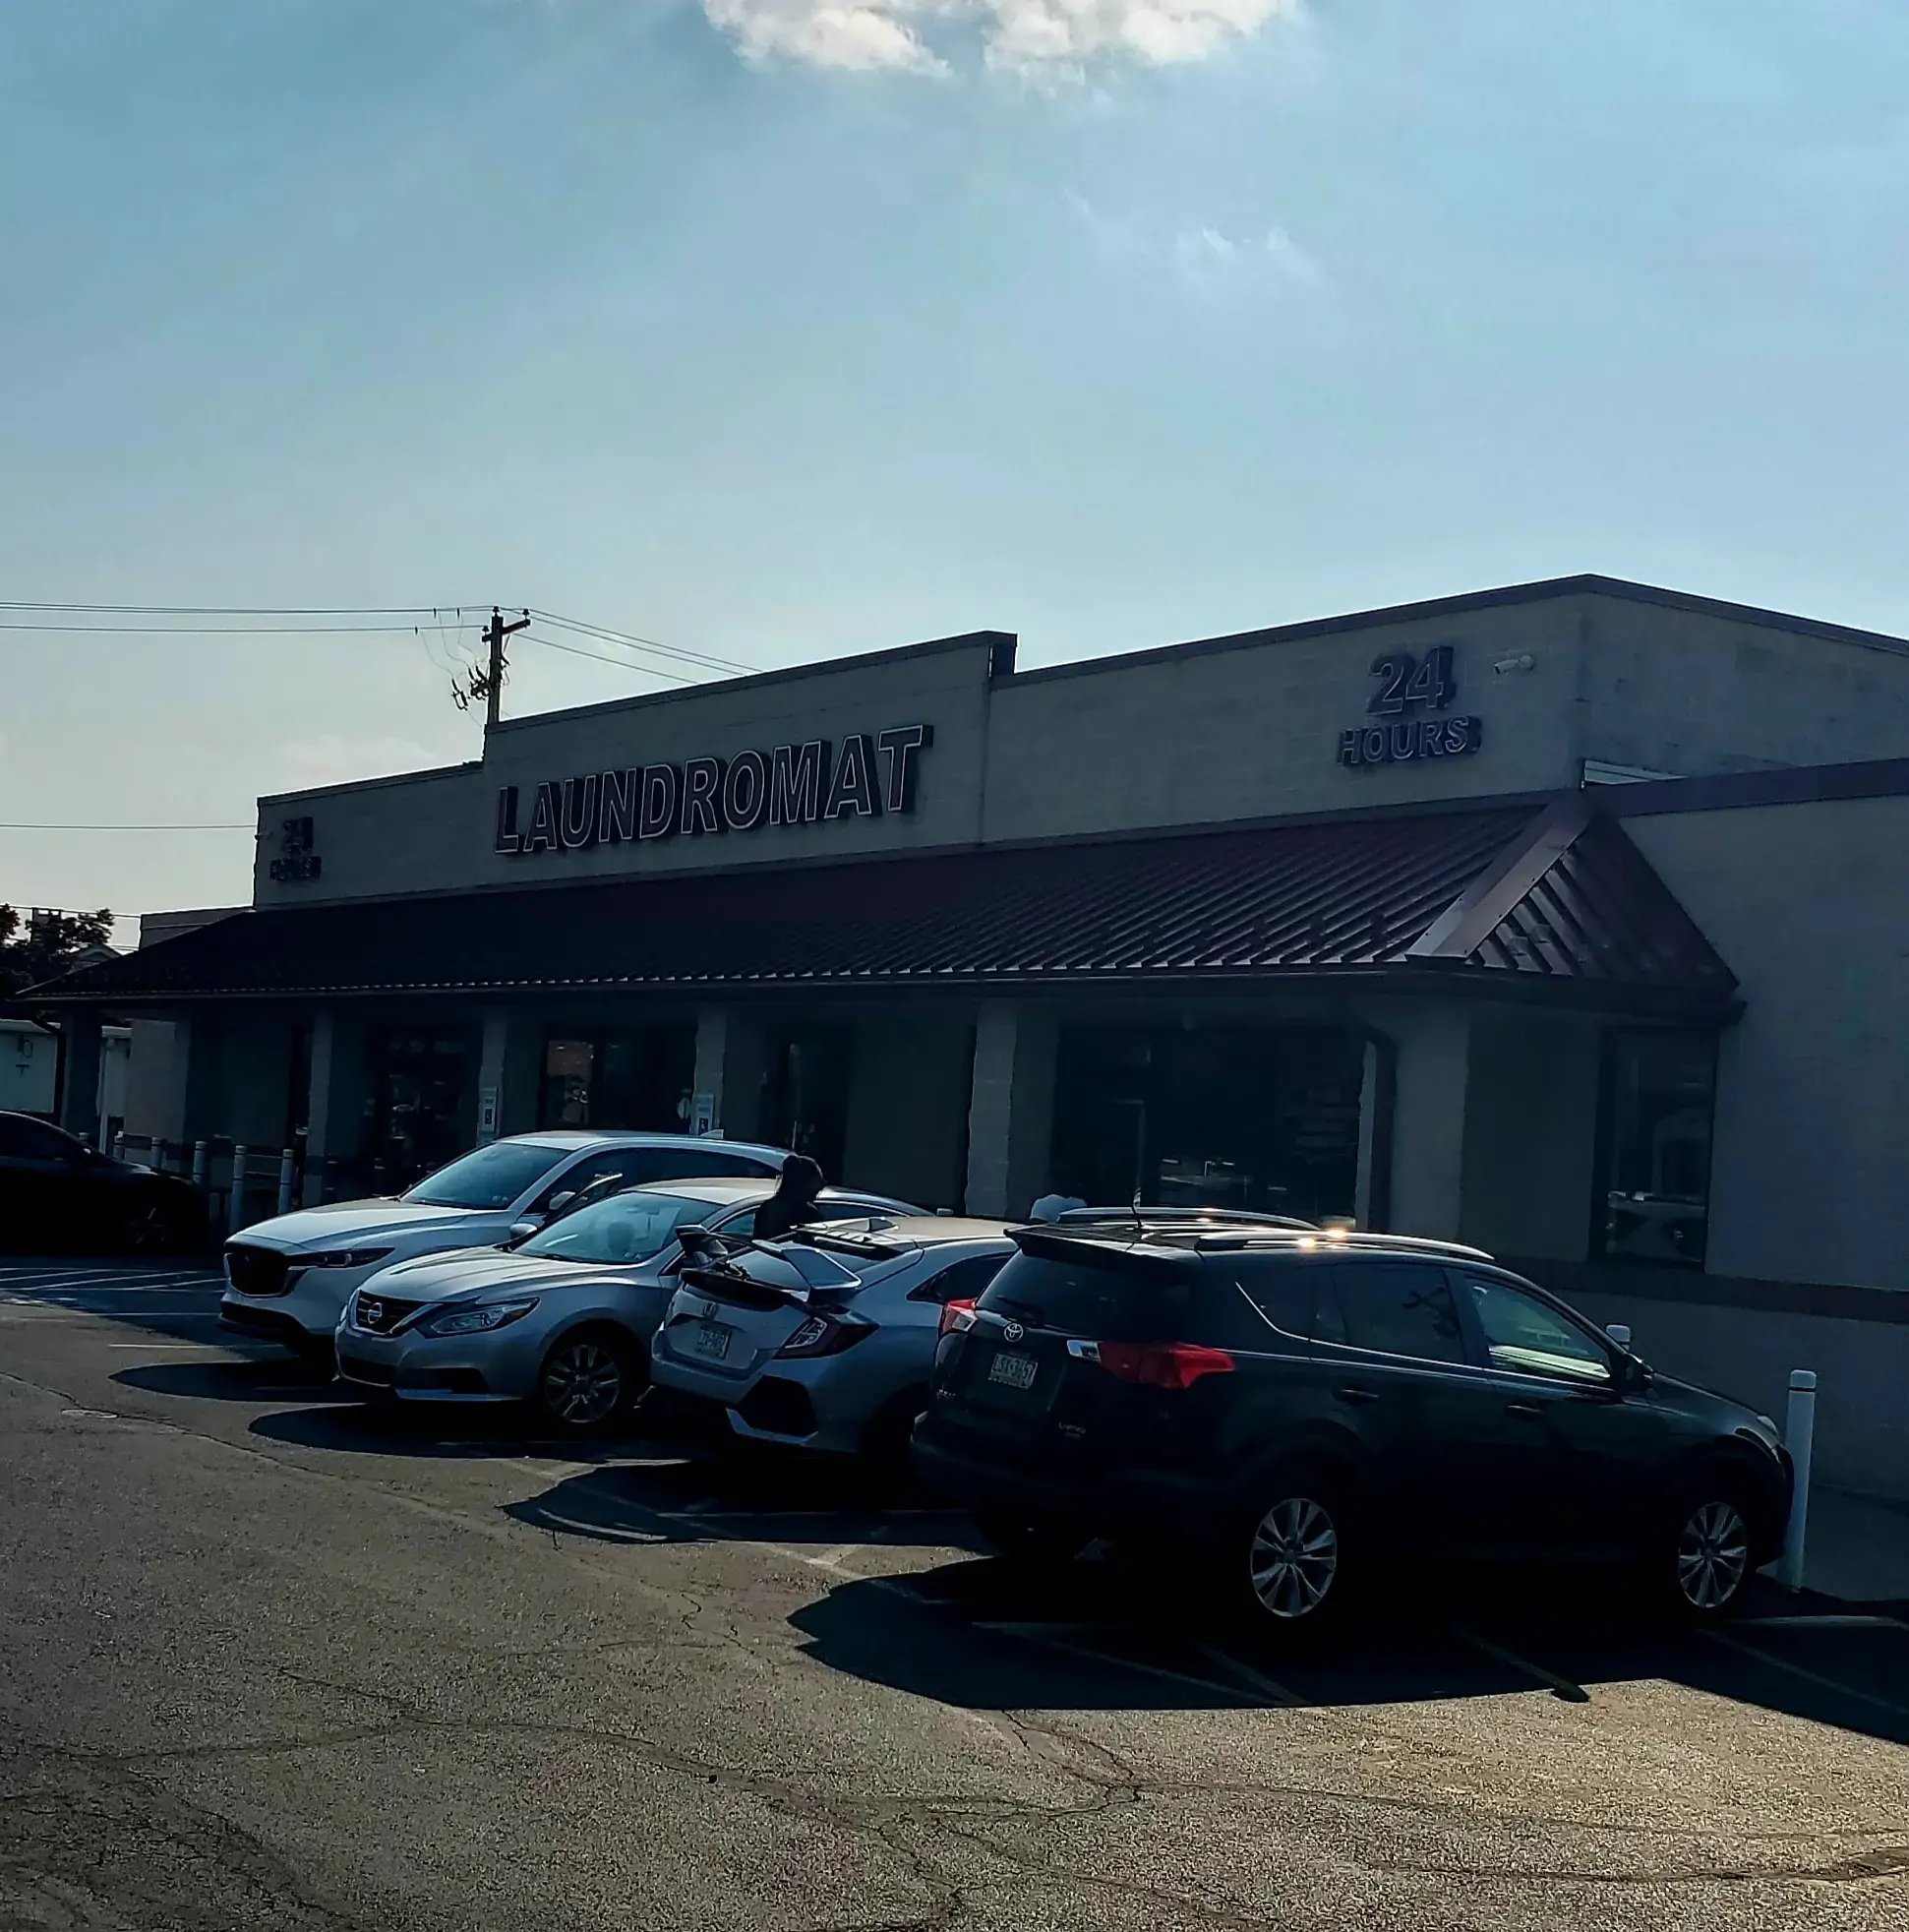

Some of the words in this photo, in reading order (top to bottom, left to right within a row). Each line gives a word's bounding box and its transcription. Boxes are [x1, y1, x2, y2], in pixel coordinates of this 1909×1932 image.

[1365, 644, 1451, 717] 24
[1337, 714, 1477, 765] HOURS
[495, 723, 928, 855] LAUNDROMAT
